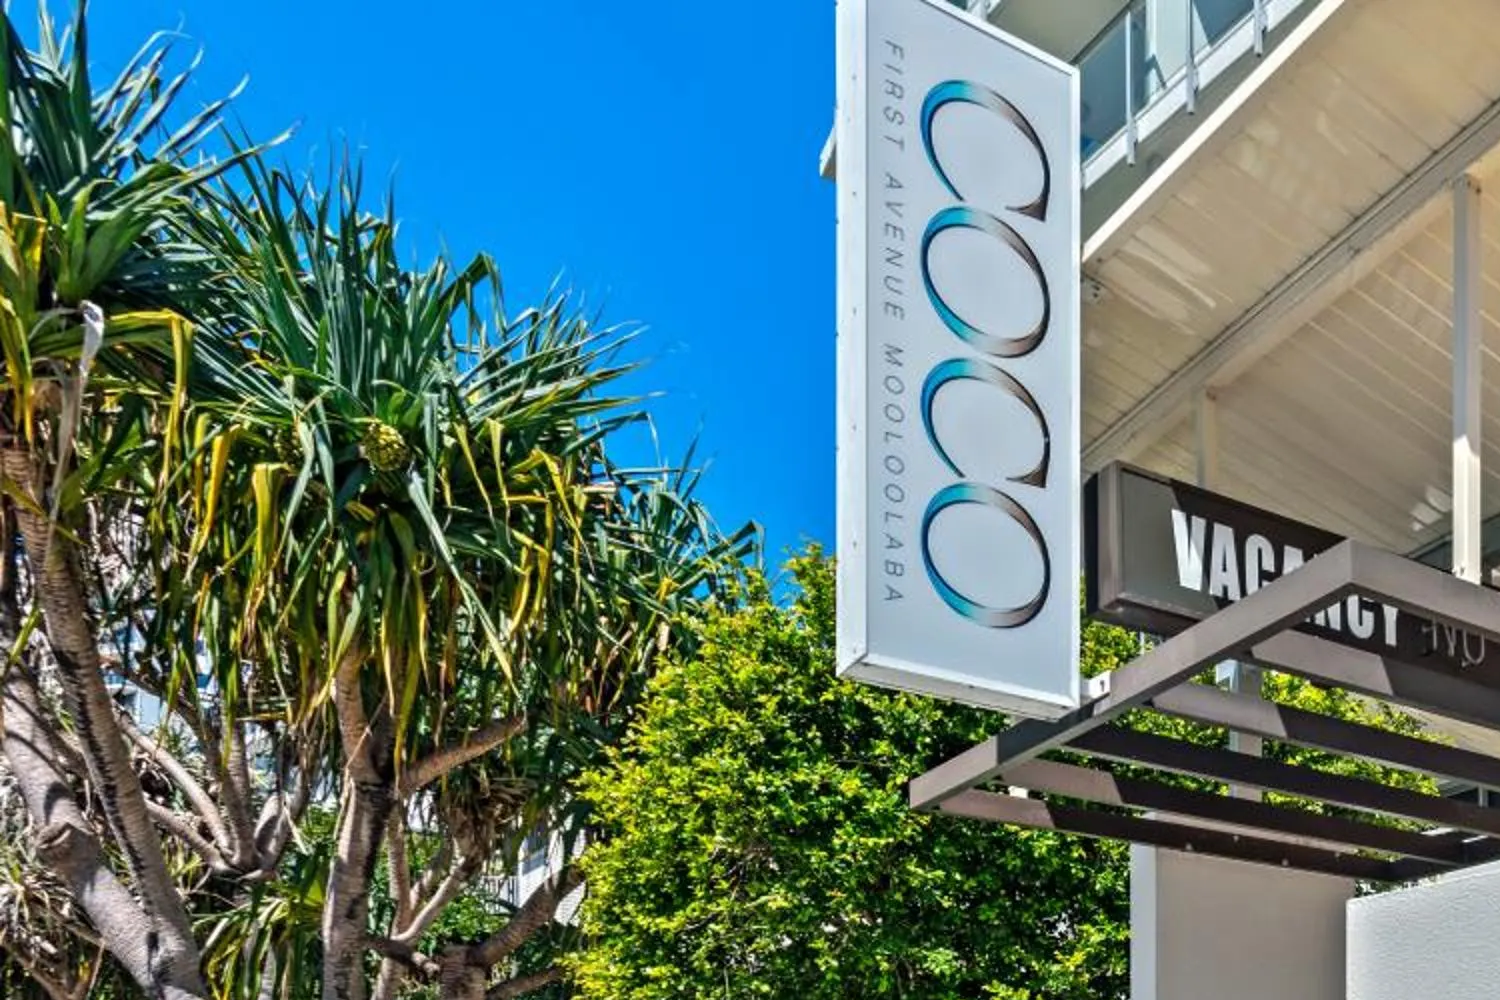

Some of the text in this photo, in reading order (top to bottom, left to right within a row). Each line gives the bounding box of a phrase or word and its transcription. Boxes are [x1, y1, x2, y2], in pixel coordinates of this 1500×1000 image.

[883, 39, 905, 602] FIRST AVENUE MOOLOOLABA
[920, 79, 1051, 629] COCO
[1171, 508, 1398, 647] VACCY
